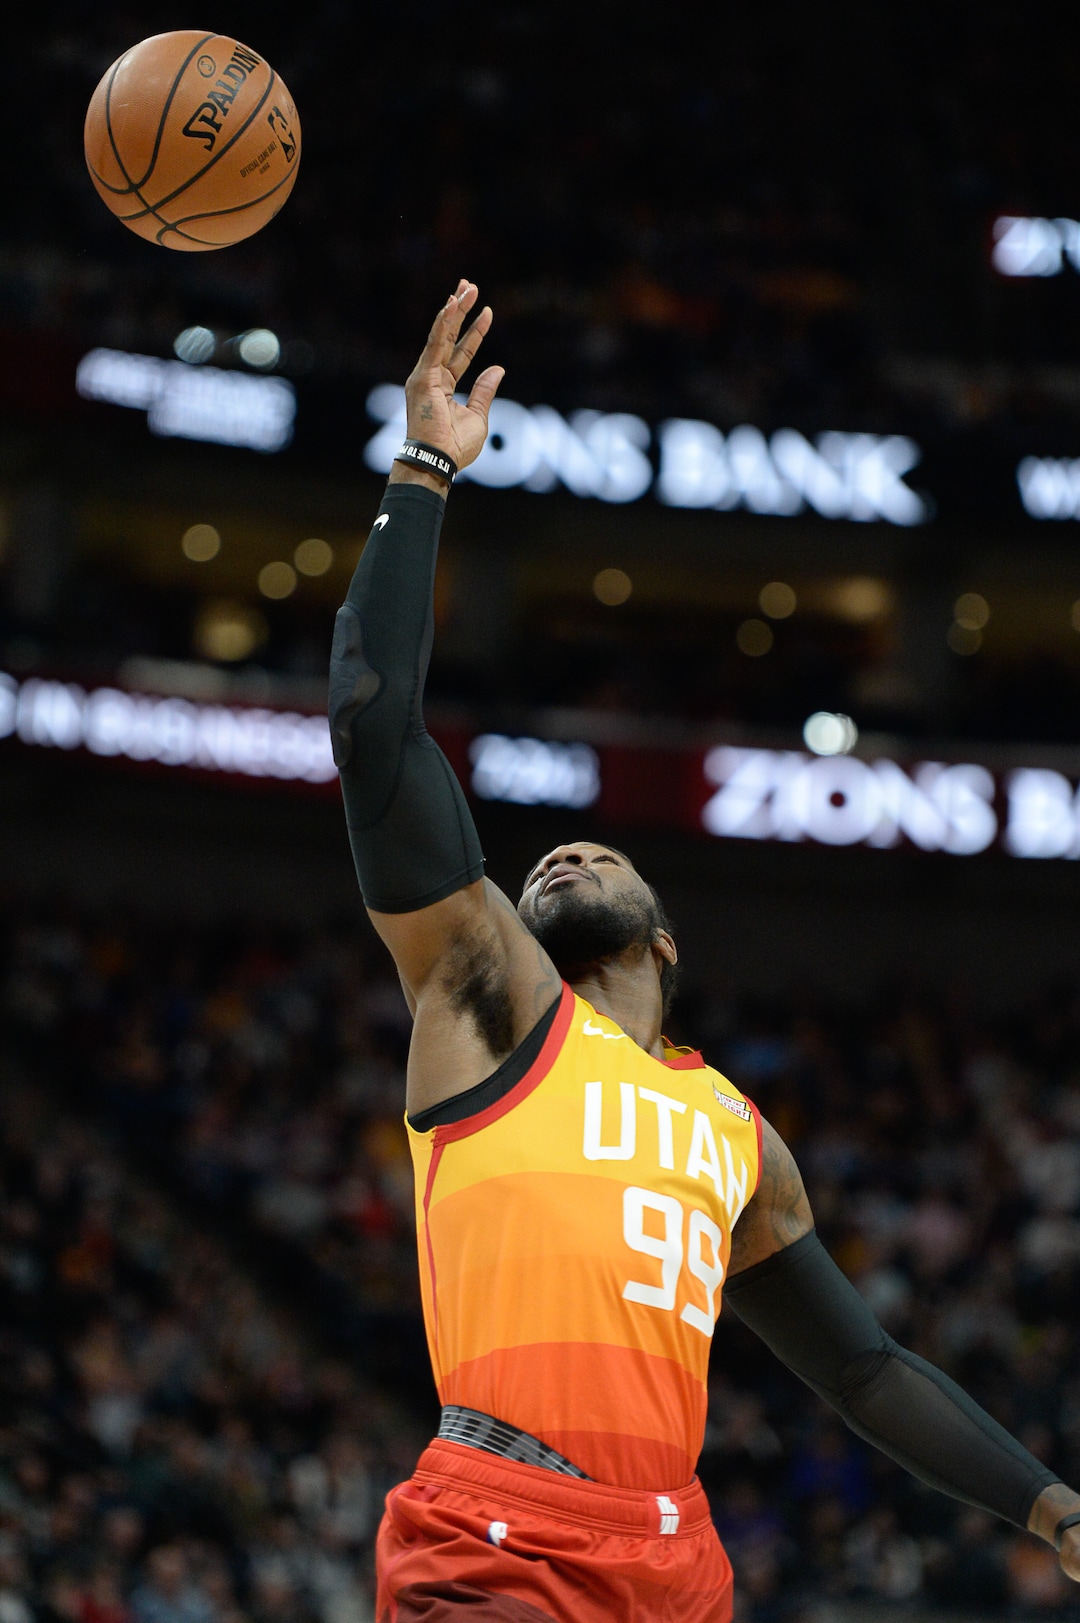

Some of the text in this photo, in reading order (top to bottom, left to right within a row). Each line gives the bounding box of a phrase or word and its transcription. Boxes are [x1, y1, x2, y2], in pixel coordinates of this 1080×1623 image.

[182, 45, 261, 152] SPALDIN
[362, 383, 653, 504] ZONS
[657, 417, 926, 527] BANK
[406, 446, 418, 458] TO
[416, 449, 438, 466] TIME
[437, 458, 451, 474] IT'S
[702, 745, 997, 855] ZIONS
[583, 1081, 749, 1234] UTAH
[621, 1186, 724, 1338] 99
